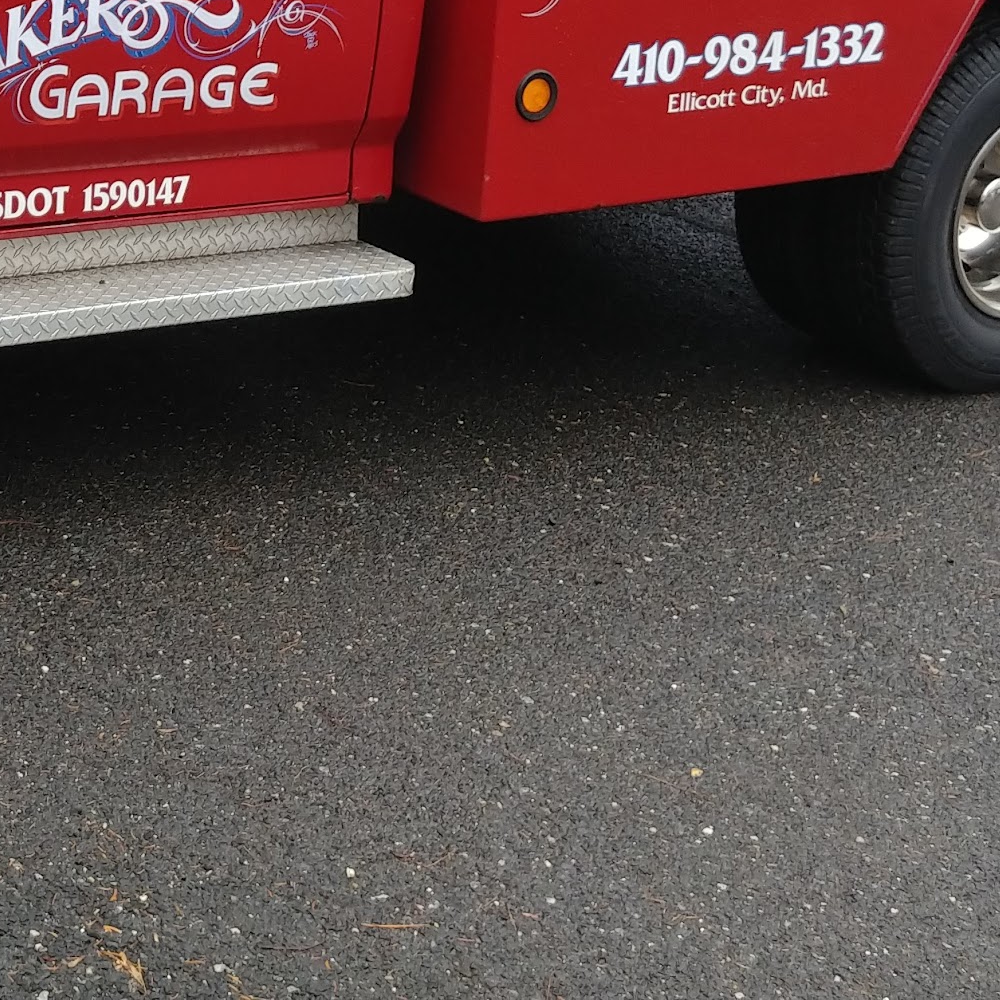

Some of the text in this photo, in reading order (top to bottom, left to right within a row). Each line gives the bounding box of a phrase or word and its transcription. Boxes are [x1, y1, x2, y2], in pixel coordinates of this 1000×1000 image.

[610, 21, 886, 88] 410-984-1332
[29, 61, 280, 121] GARAGE
[667, 77, 829, 114] Ellicott City, Md.
[82, 175, 191, 213] 1590147
